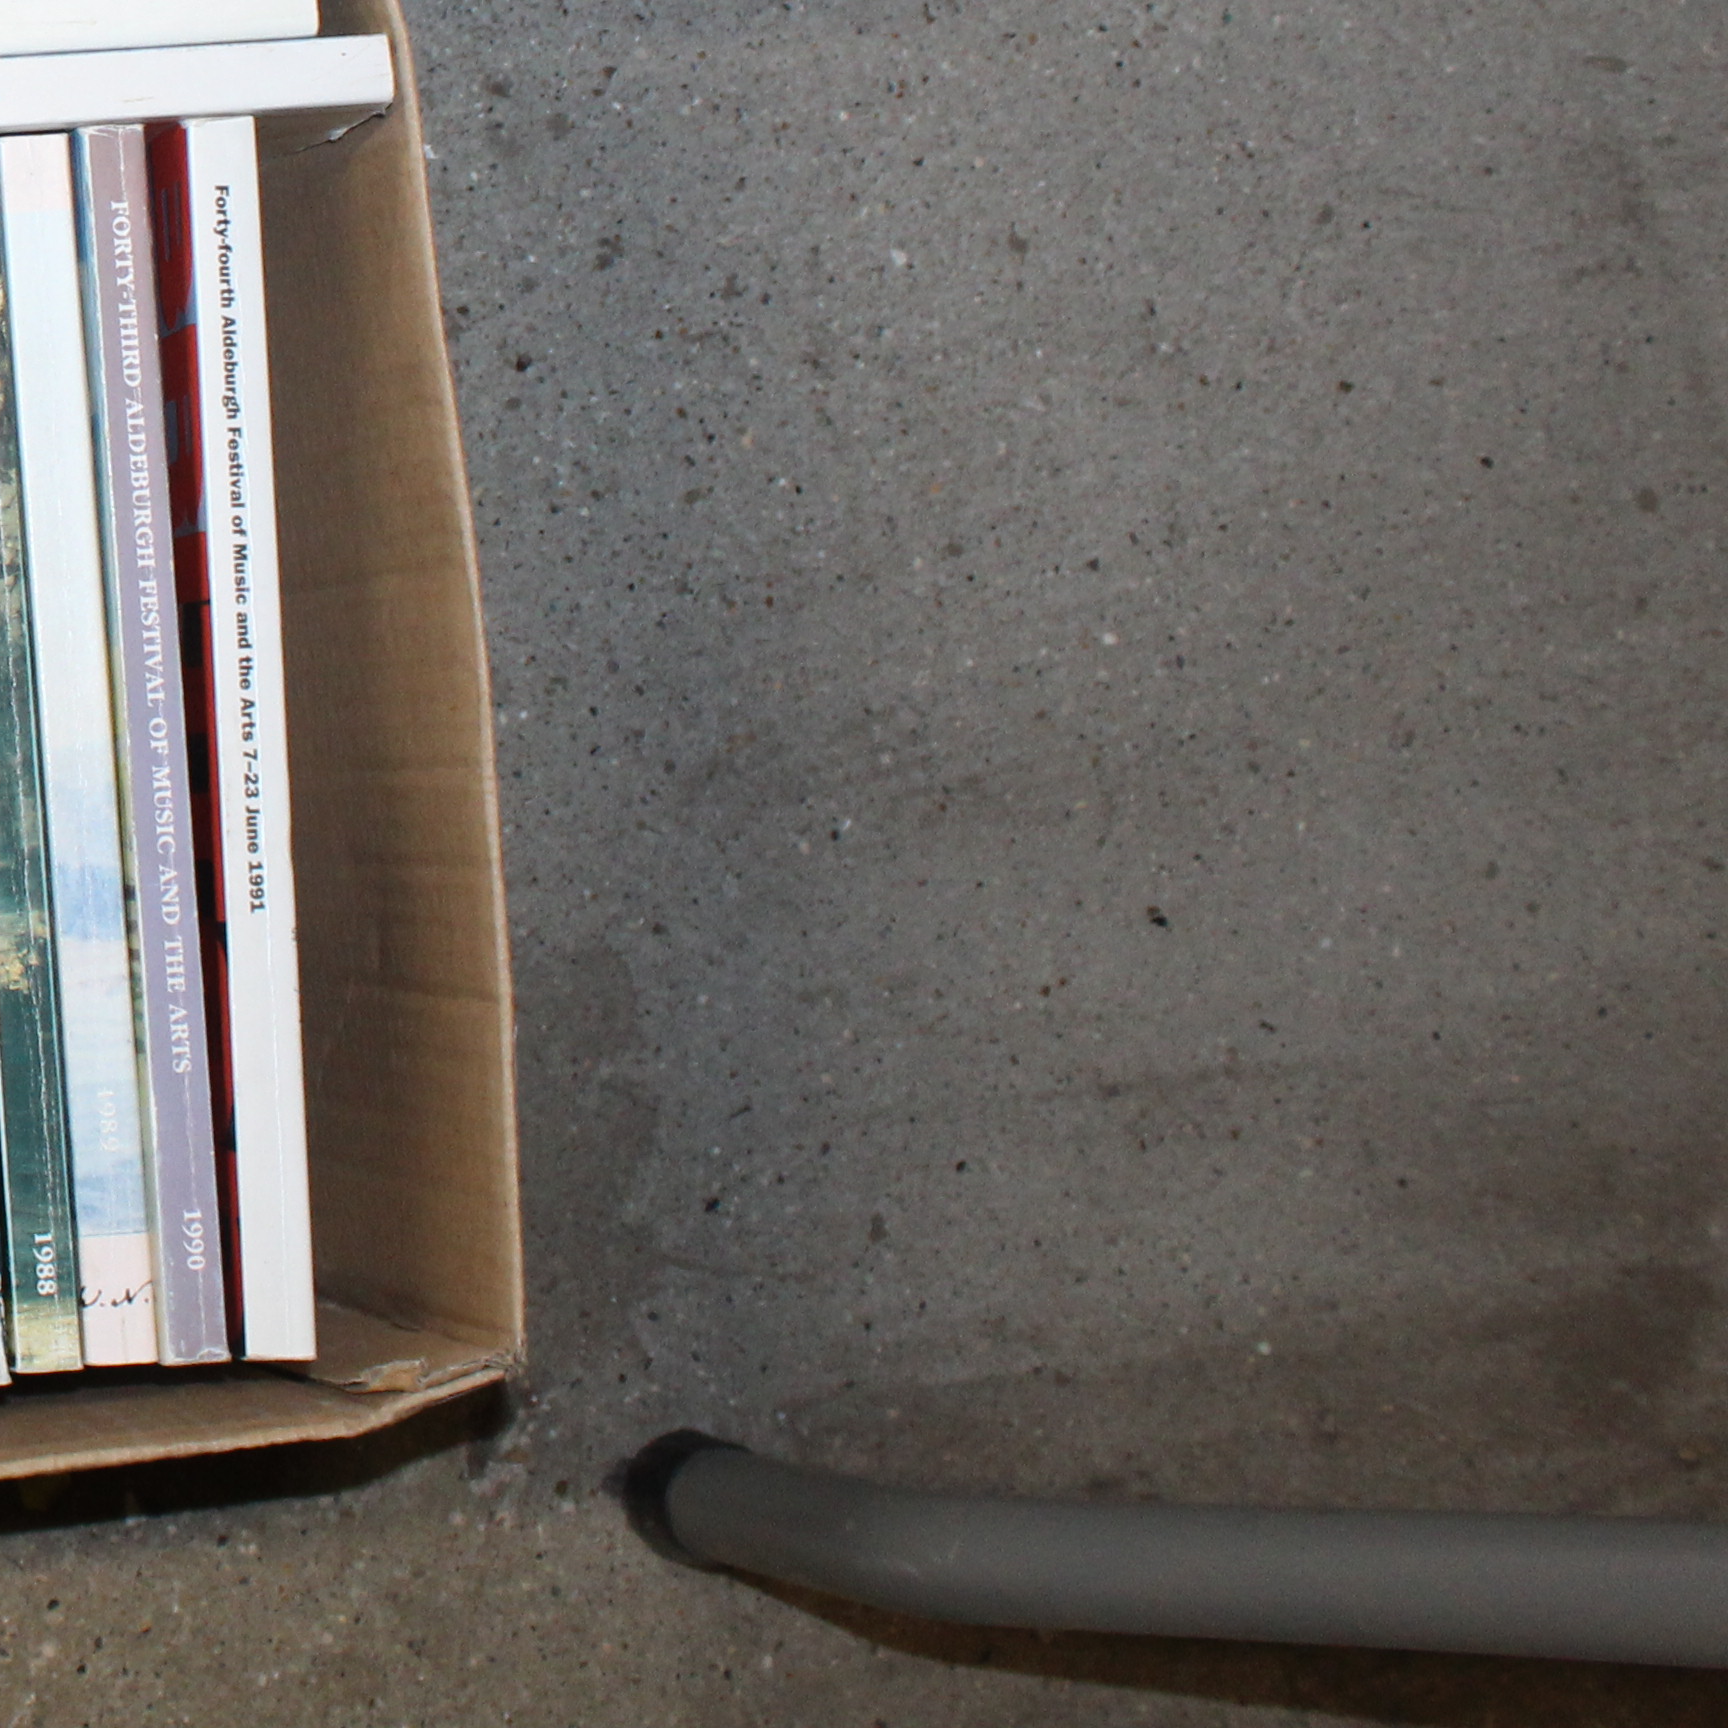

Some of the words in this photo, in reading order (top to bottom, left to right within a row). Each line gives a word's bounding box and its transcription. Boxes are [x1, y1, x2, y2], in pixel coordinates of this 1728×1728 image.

[214, 185, 235, 308] Forty-fourth
[111, 203, 142, 387] FORTY-THIRD
[222, 316, 241, 419] Aldeburgh
[122, 399, 156, 567] ALDEBURGH
[227, 427, 245, 508] Festival
[232, 515, 247, 537] of
[233, 544, 250, 604] Music
[138, 580, 167, 707] FESTIVAL
[236, 612, 252, 649] and
[239, 656, 253, 690] the
[148, 718, 171, 755] OF
[241, 698, 256, 742] Arts
[243, 749, 259, 799] 7–23
[150, 765, 176, 854] MUSIC
[245, 806, 260, 854] June
[158, 865, 181, 925] AND
[248, 862, 265, 913] 1991
[163, 935, 185, 994] THE
[168, 1003, 192, 1074] ARTS
[33, 1232, 56, 1296] 1988
[182, 1208, 207, 1271] 1990
